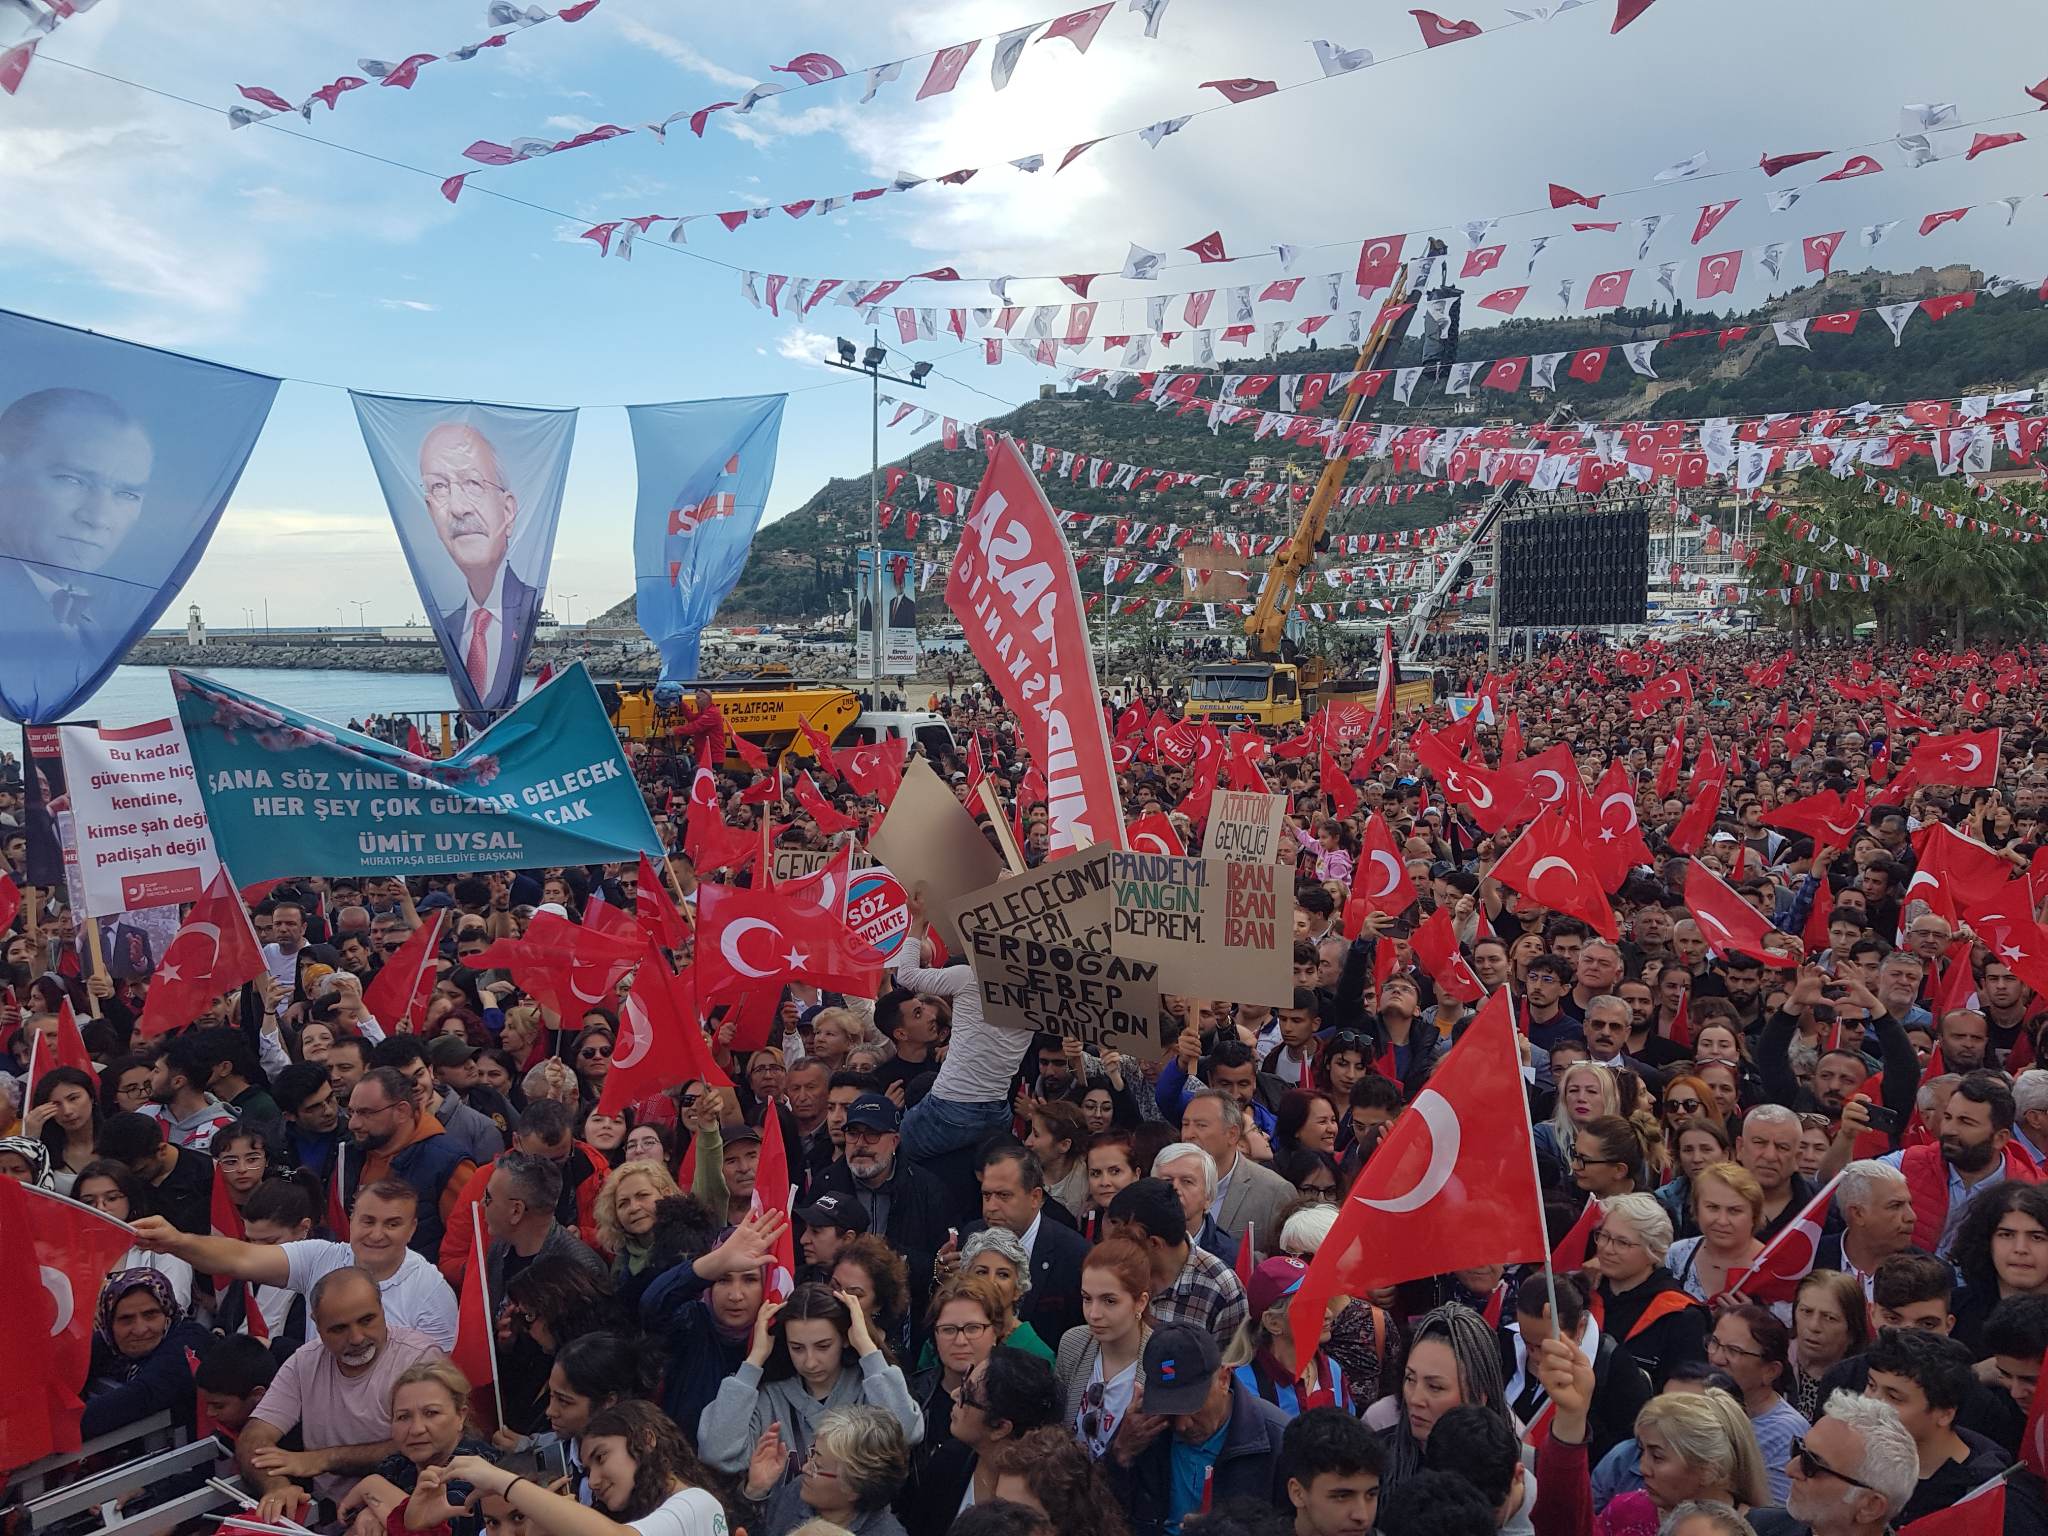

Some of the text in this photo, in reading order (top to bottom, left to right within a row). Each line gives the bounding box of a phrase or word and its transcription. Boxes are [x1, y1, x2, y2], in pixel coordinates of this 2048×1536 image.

[732, 702, 784, 715] PLATFORM
[1339, 725, 1361, 736] CHP
[110, 742, 180, 761] Bu kadar
[91, 764, 194, 790] güvenme hiç
[280, 768, 330, 791] SÖZ
[337, 768, 400, 791] YİNE
[521, 758, 622, 807] GELECEK
[111, 793, 183, 810] kendine,
[252, 797, 305, 816] HER
[314, 798, 361, 822] ŞEY
[370, 797, 423, 823] ÇOK
[87, 811, 208, 840] kimse şah deği
[1215, 820, 1269, 856] GENÇLİĞİ
[96, 837, 207, 868] padişah değil
[358, 829, 523, 854] ÜMİT UYSAL
[360, 850, 524, 867] MURATPAŞA BELEDİYE BAŞKANI
[848, 892, 890, 926] SÖZ
[1114, 907, 1206, 944] DEPREM.
[1005, 964, 1122, 1010] SEBEP
[984, 980, 1149, 1040] ENFLASYON
